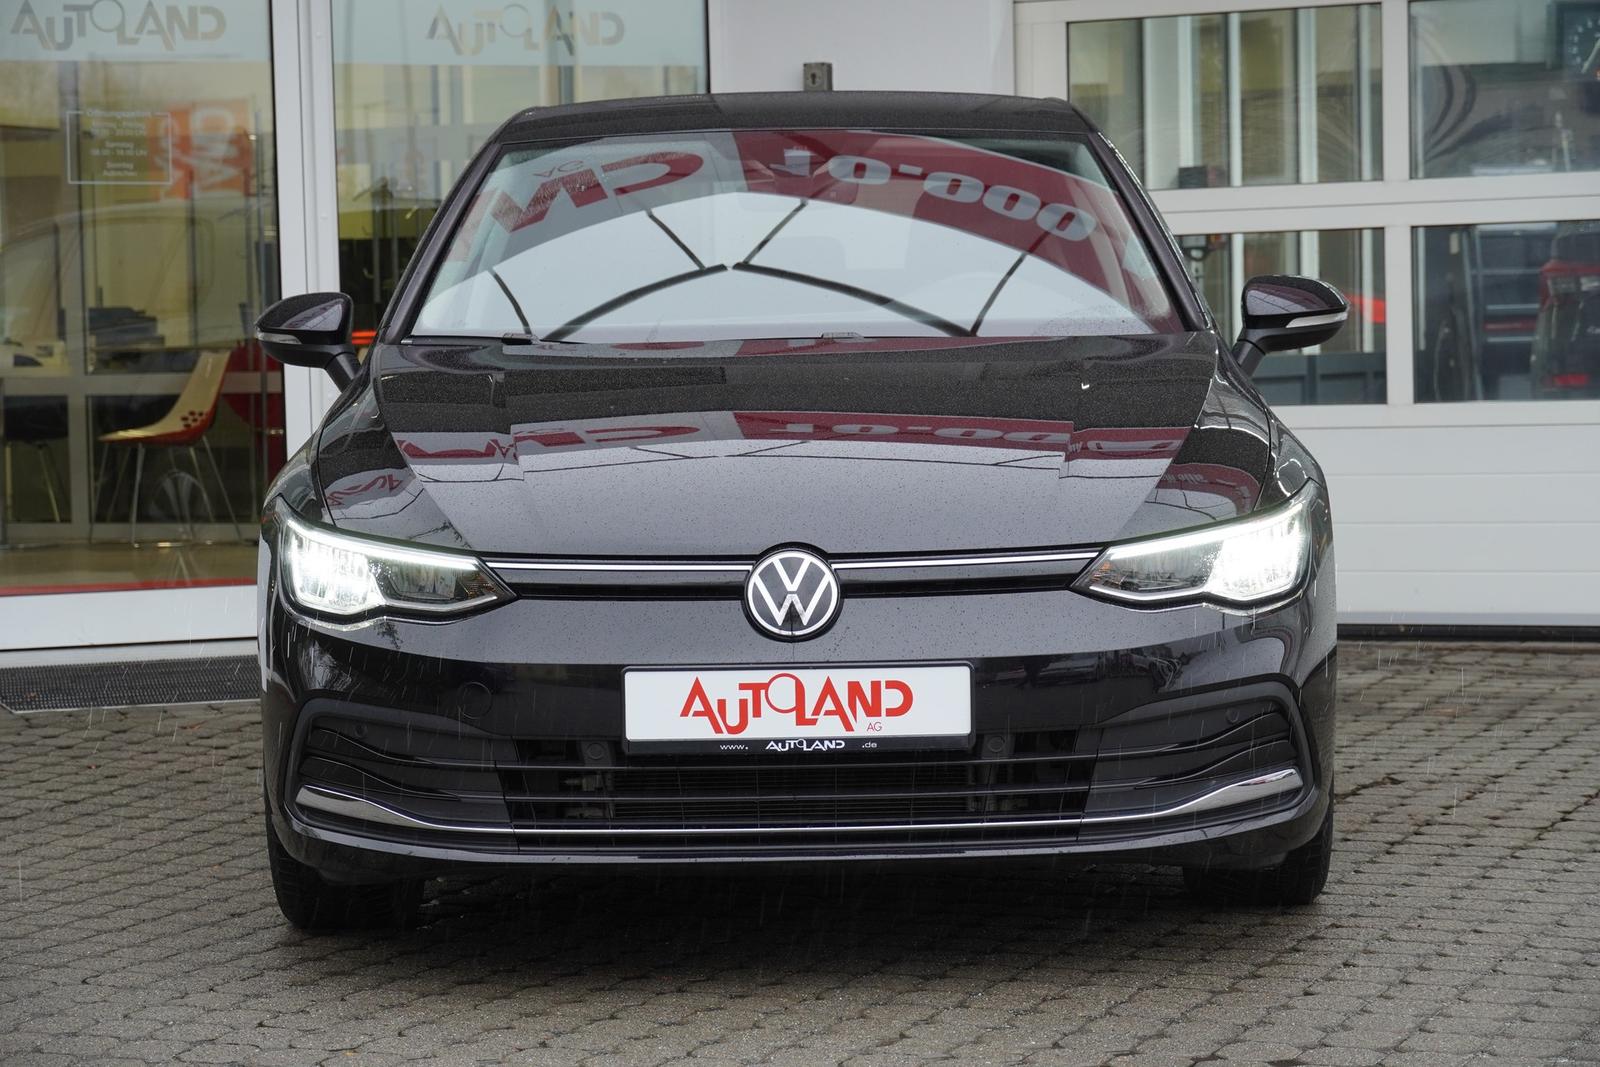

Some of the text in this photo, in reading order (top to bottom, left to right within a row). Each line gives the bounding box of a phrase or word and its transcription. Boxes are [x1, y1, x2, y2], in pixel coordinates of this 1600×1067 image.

[10, 0, 227, 51] AUTOLAND
[680, 672, 913, 735] AUTOLAND
[866, 722, 883, 733] AG
